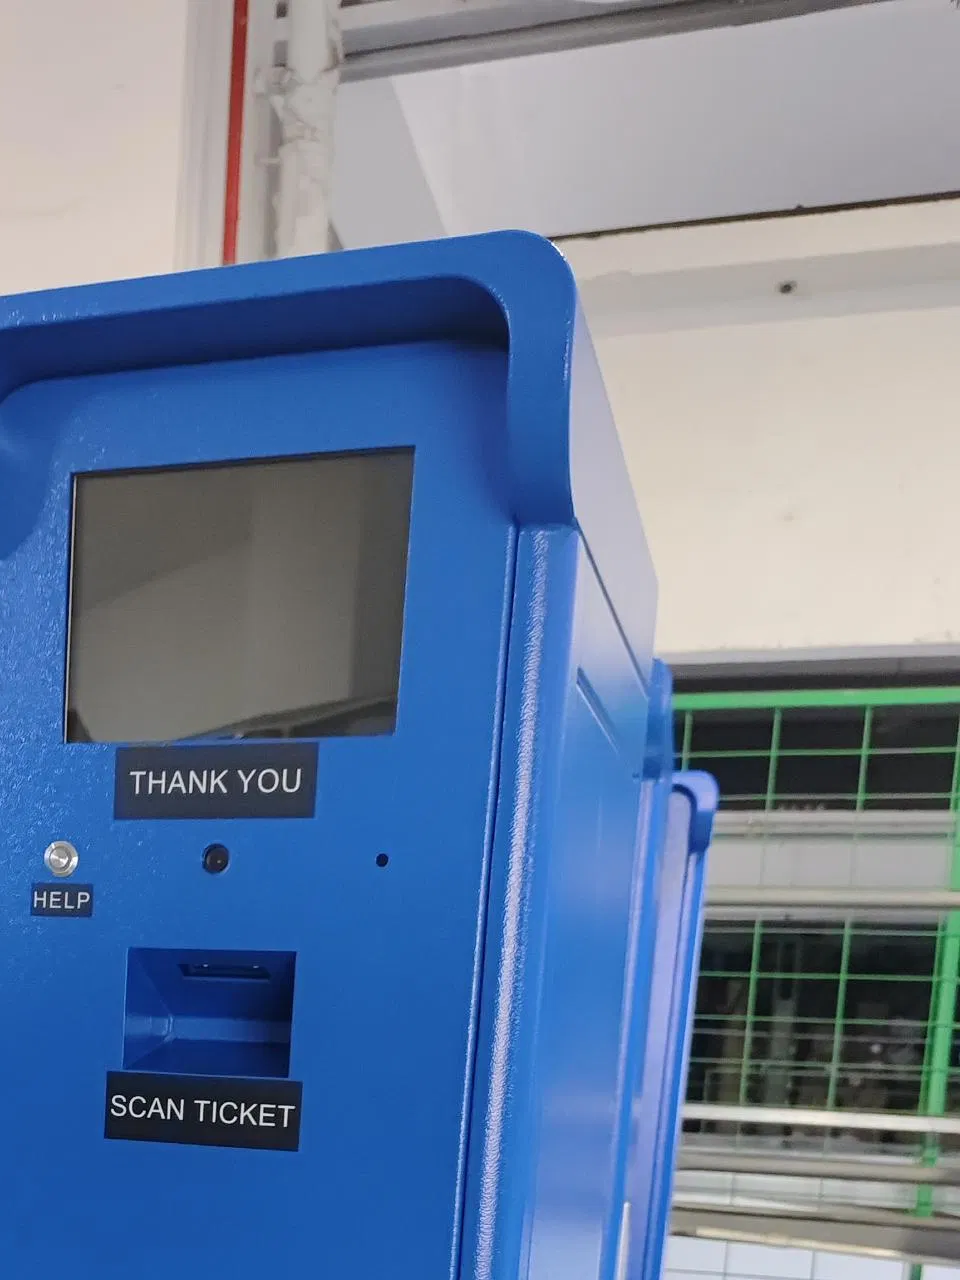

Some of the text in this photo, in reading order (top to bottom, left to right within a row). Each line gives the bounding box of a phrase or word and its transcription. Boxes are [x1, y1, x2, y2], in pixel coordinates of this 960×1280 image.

[129, 768, 302, 794] THANK YOU
[33, 890, 91, 909] HELP
[110, 1094, 296, 1128] SCAN TICKET
